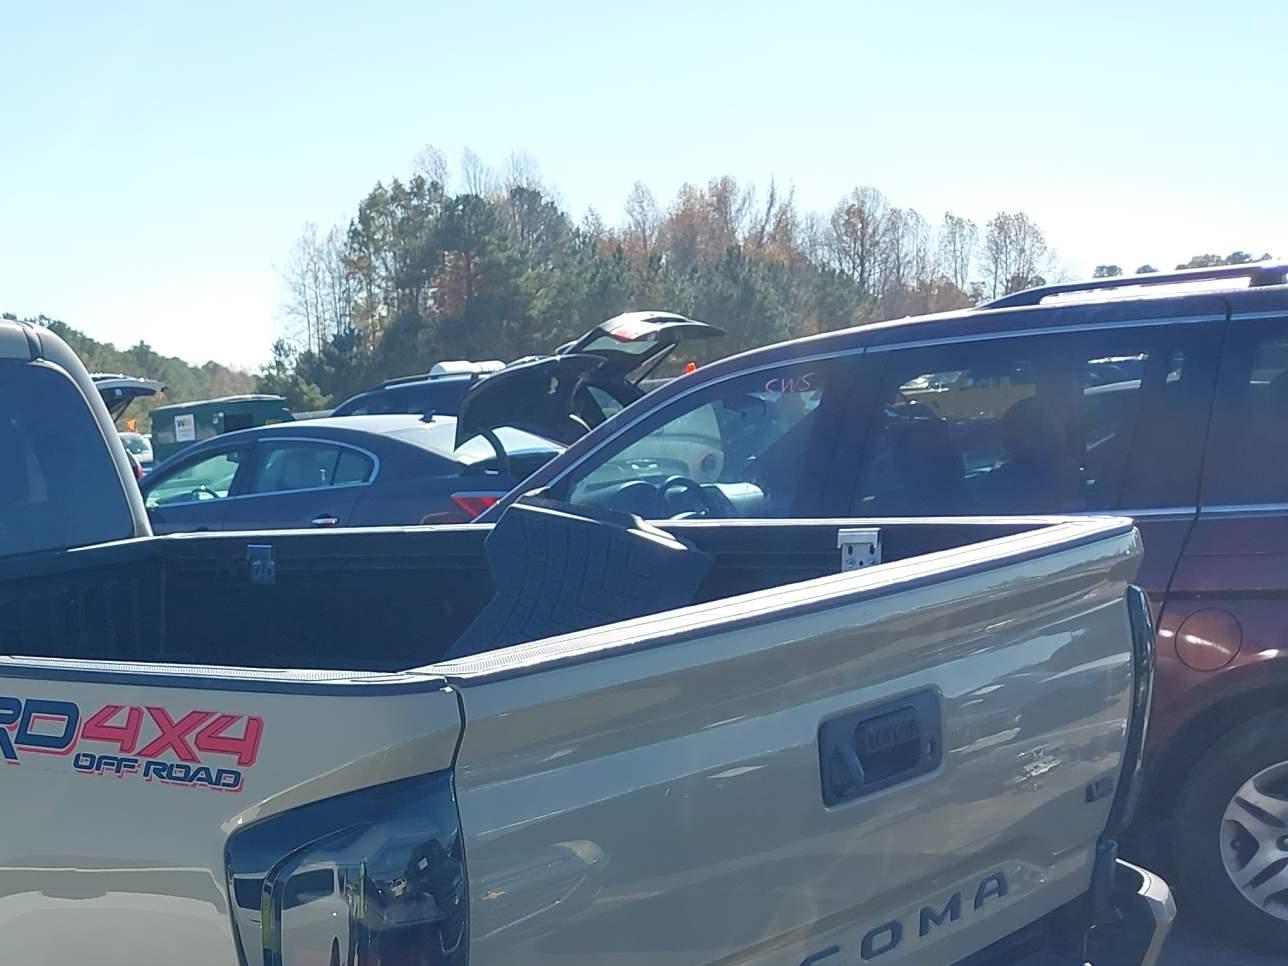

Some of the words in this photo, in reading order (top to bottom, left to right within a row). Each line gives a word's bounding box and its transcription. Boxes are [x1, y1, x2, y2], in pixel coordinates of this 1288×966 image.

[82, 704, 265, 768] 4X4
[72, 752, 138, 778] OFF
[142, 760, 245, 792] ROAD
